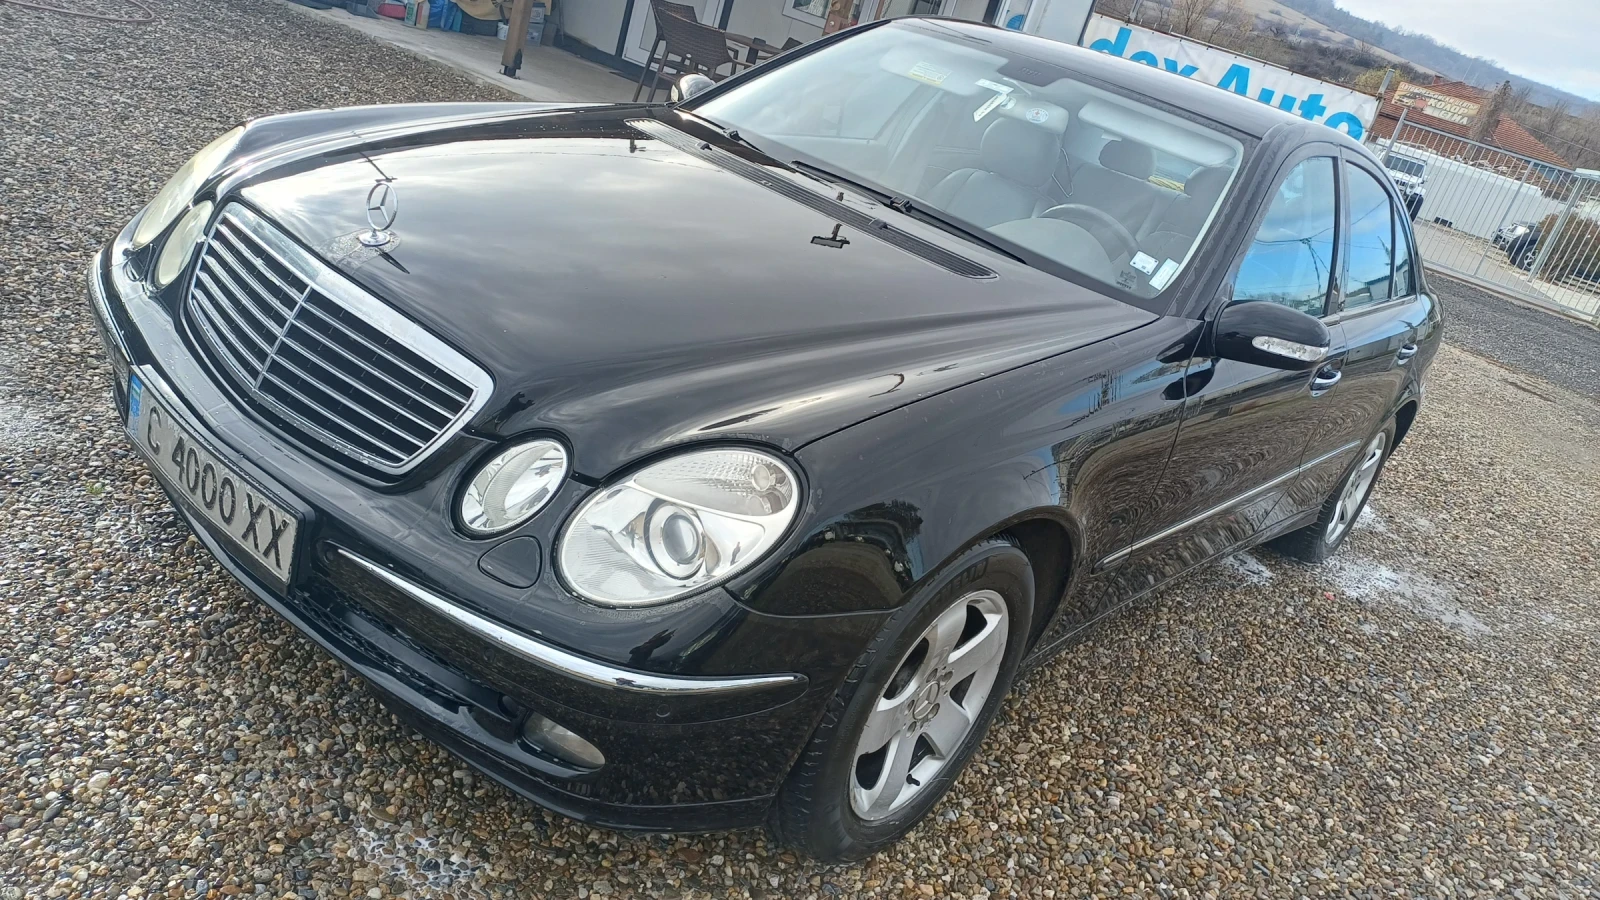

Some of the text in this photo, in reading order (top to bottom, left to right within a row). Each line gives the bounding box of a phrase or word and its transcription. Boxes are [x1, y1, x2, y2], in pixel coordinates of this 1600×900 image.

[1428, 99, 1469, 115] КОЛОР
[1439, 110, 1469, 125] СТИЛ
[148, 406, 290, 571] C 4000 XX
